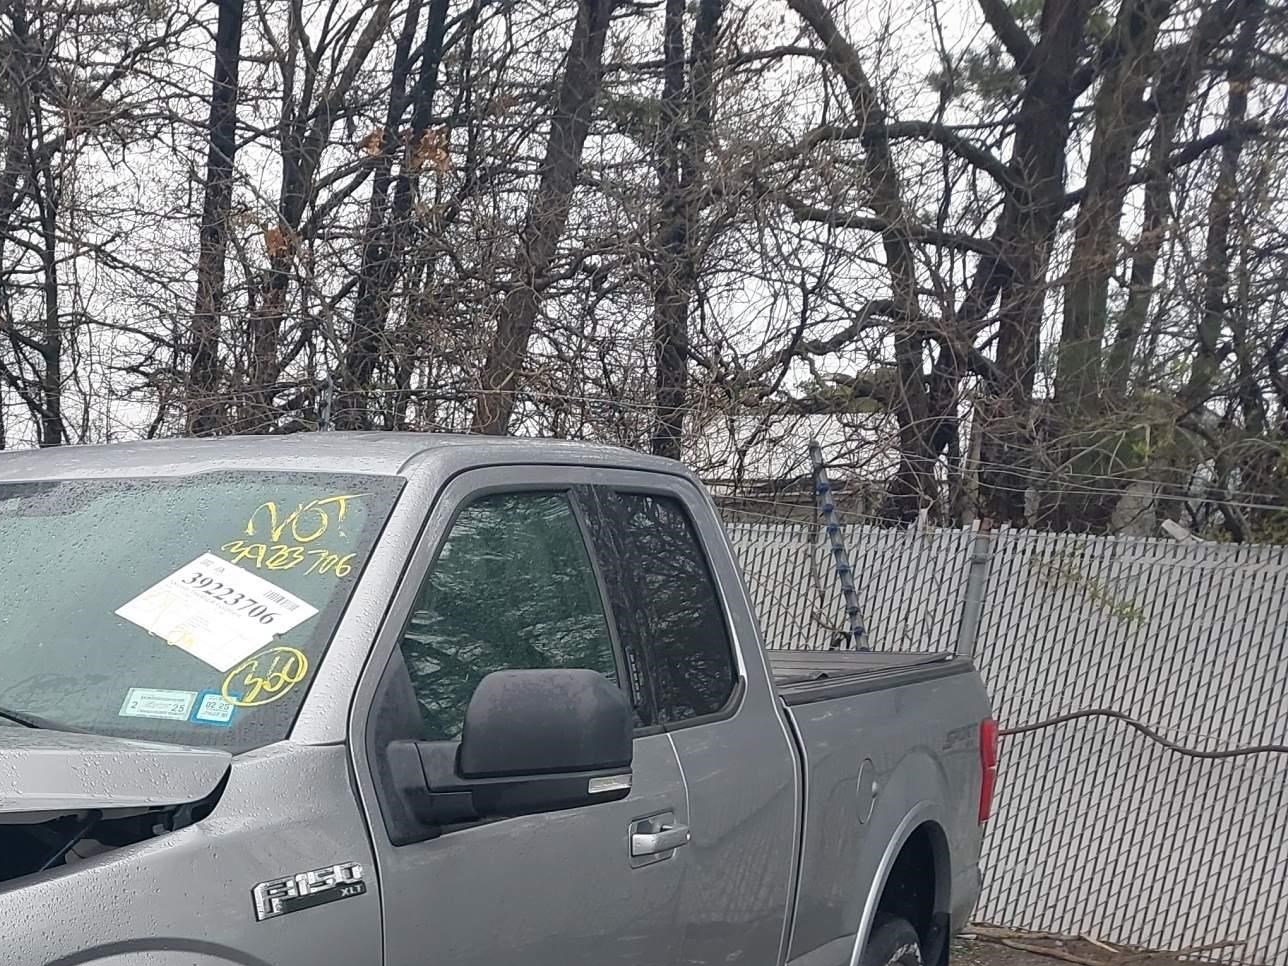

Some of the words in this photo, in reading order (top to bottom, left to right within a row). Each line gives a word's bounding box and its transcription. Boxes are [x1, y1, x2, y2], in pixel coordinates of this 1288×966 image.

[244, 492, 374, 542] NOT
[181, 572, 281, 625] 39223706
[171, 703, 185, 713] 25
[339, 884, 363, 898] XLT
